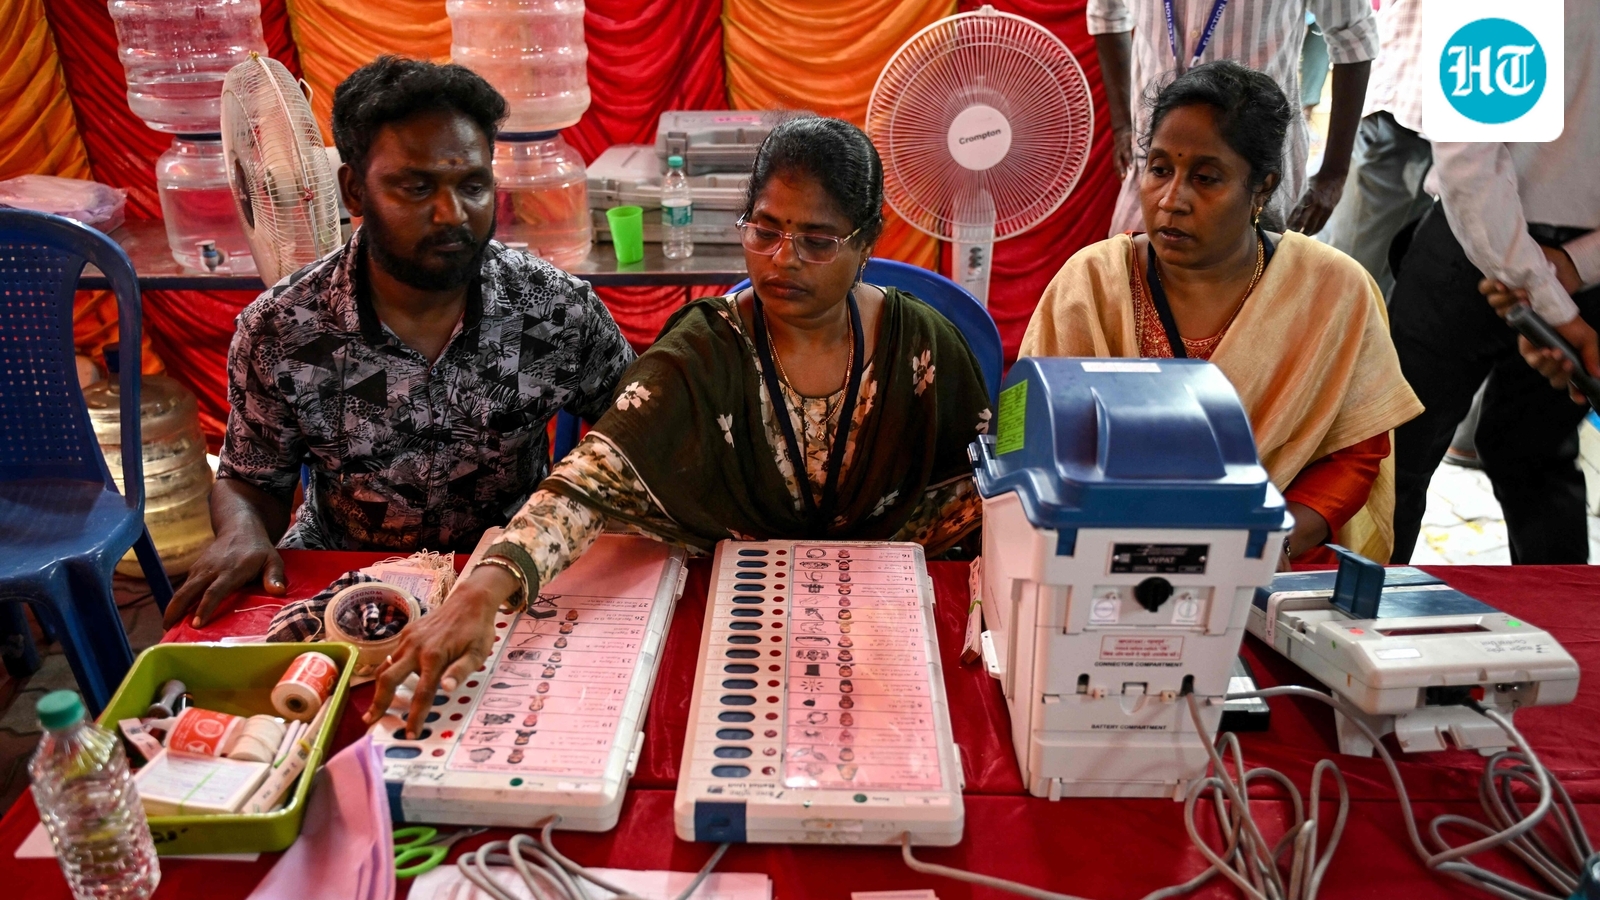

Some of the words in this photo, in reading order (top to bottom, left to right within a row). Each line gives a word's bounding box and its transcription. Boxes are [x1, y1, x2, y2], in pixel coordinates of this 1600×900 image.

[1164, 2, 1174, 45] ELECTION
[1202, 3, 1226, 46] ELECTION
[958, 128, 1002, 145] Crompton
[1147, 556, 1176, 565] VVPAT
[350, 590, 383, 601] WONDER
[350, 597, 383, 606] WONDER
